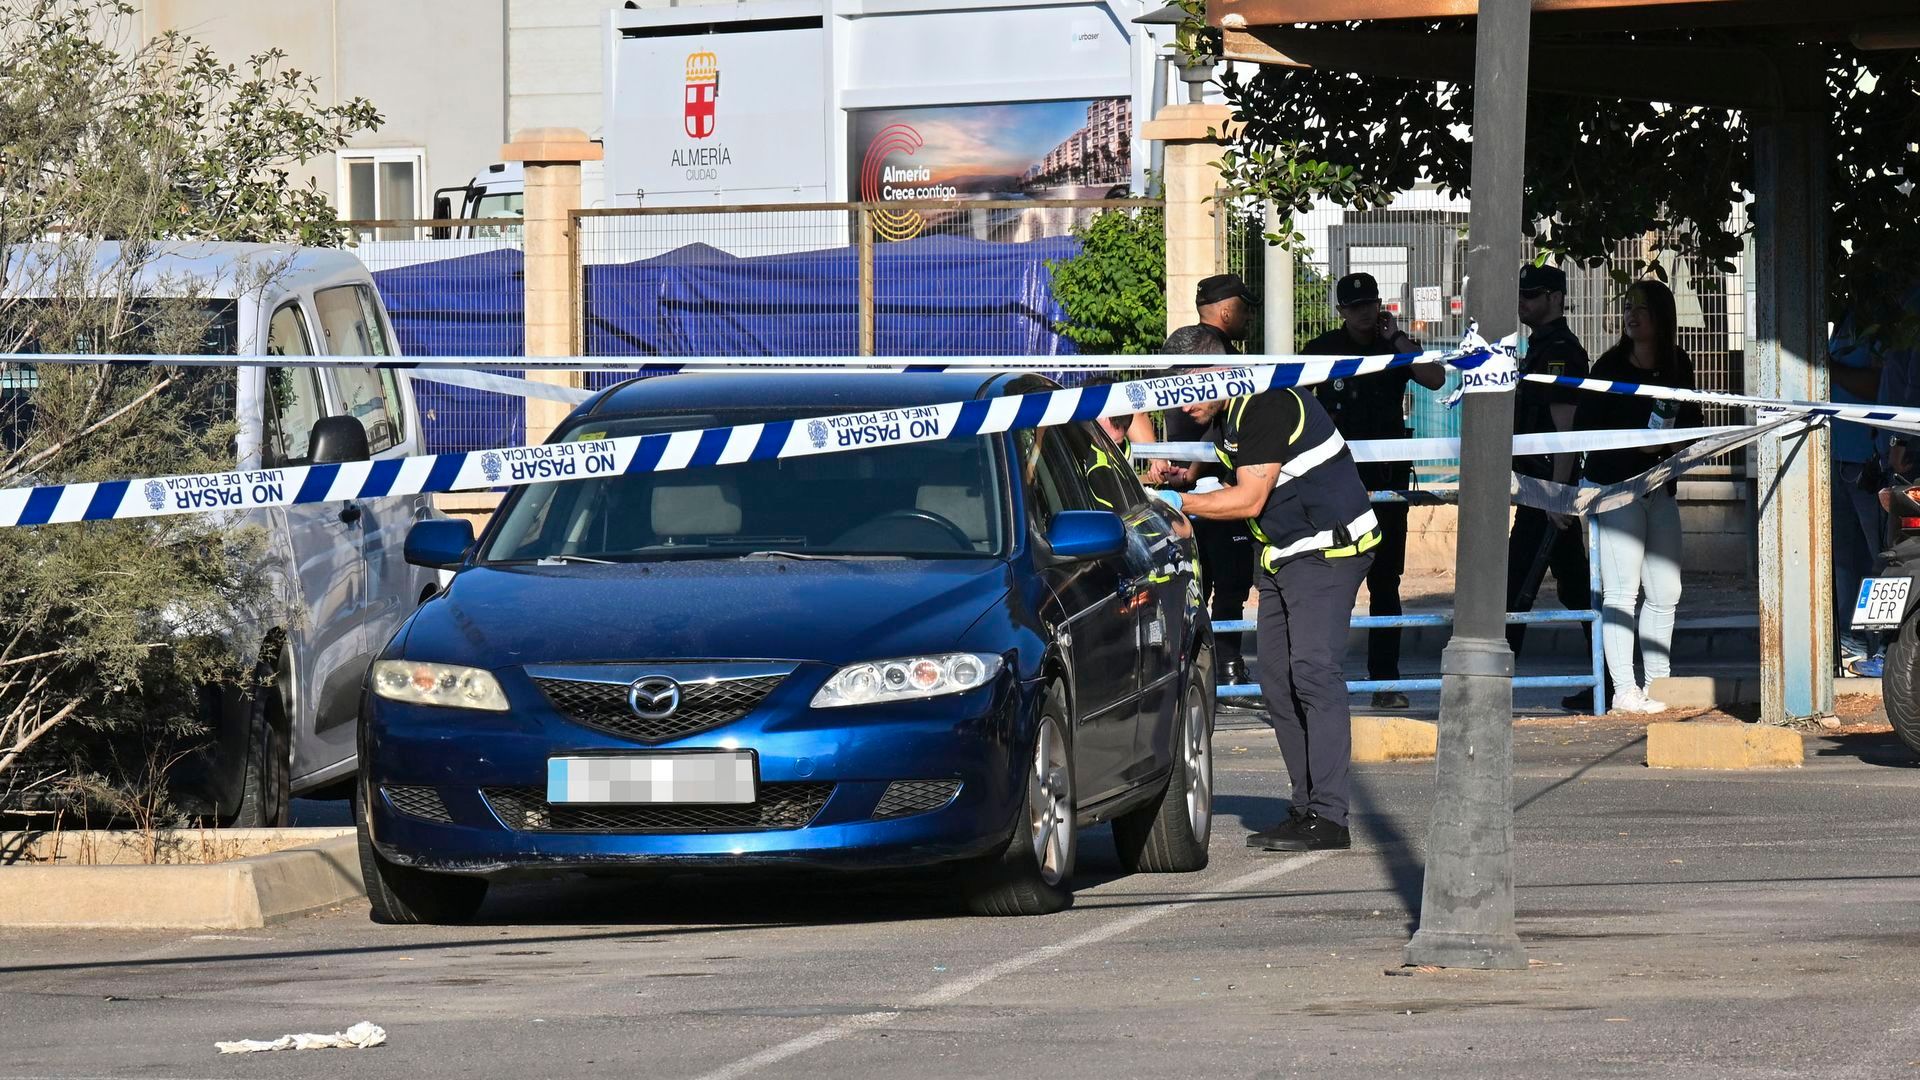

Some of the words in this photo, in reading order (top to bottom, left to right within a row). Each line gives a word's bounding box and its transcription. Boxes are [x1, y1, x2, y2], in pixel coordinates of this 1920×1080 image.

[671, 143, 732, 167] ALMERÍA
[685, 168, 718, 181] CIUDAD
[883, 185, 915, 201] Crece
[916, 184, 957, 202] contigo
[1196, 372, 1214, 384] DE
[1217, 366, 1254, 380] LINEA
[1144, 375, 1194, 390] POLICIA
[1225, 379, 1256, 397] NO
[1154, 384, 1218, 407] PASAR
[827, 413, 877, 428] POLICIA
[880, 411, 899, 422] DE
[901, 406, 940, 420] LINEA
[837, 422, 901, 446] PASAR
[909, 418, 939, 438] NO
[502, 446, 552, 461] POLICIA
[556, 444, 575, 456] DE
[578, 440, 616, 454] LINEA
[511, 457, 576, 480] PASAR
[585, 453, 615, 474] NO
[166, 475, 219, 490] POLICIA
[222, 473, 241, 486] DE
[245, 470, 284, 484] LINEA
[175, 486, 243, 509] PASAR
[252, 483, 283, 504] NO
[1871, 582, 1908, 600] 5656
[1868, 601, 1897, 620] LFR
